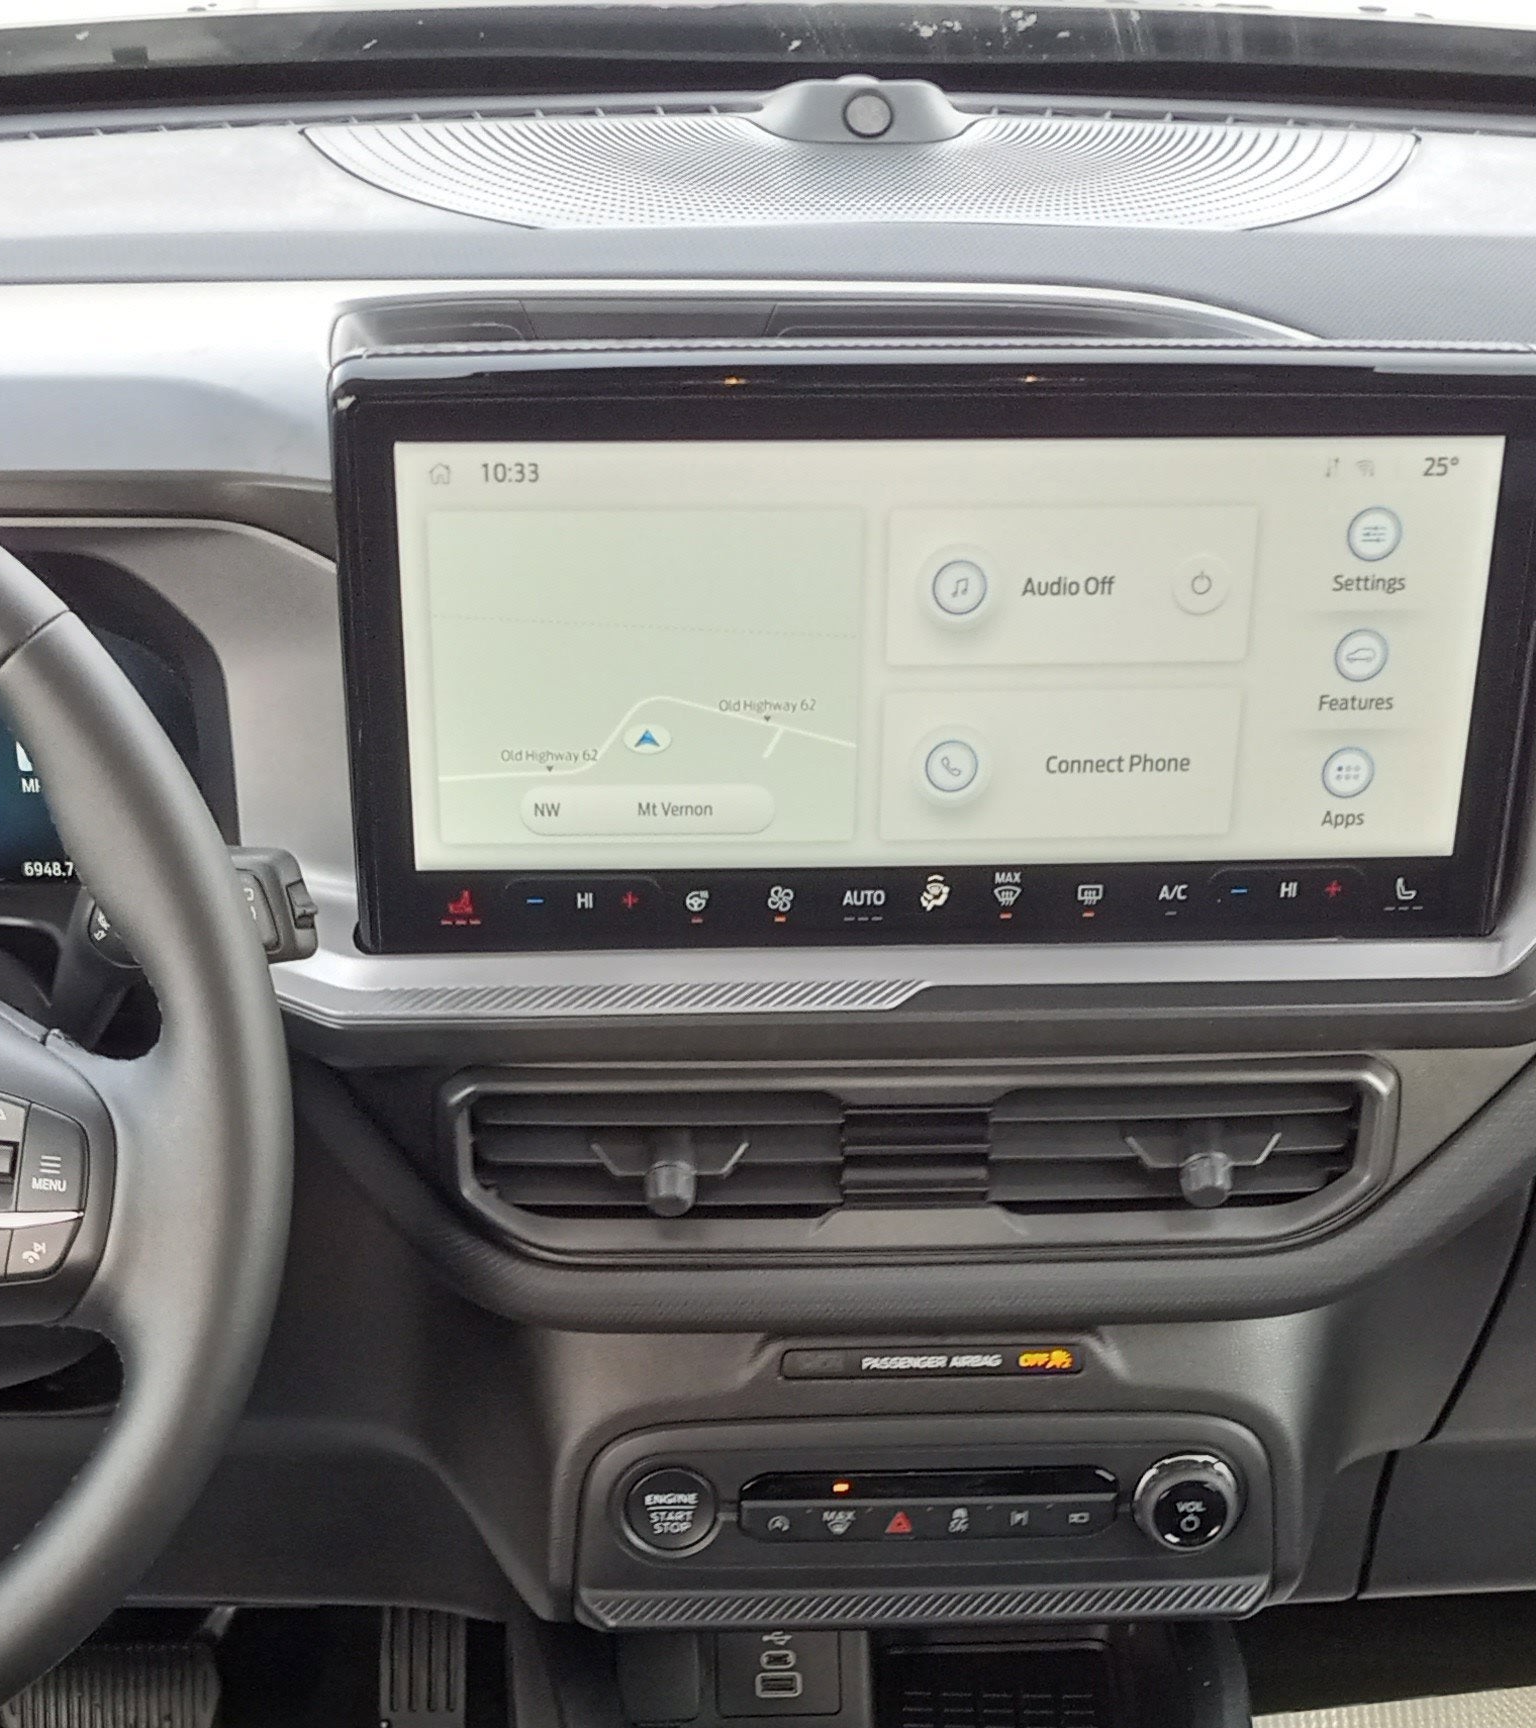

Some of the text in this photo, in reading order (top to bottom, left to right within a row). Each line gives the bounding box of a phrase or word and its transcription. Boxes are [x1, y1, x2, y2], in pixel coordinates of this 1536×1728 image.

[480, 463, 541, 484] 10:33
[1422, 456, 1460, 477] 25°
[1021, 575, 1115, 597] Audio Off
[1332, 573, 1407, 594] Settings
[718, 698, 817, 713] Old Highway 62
[1318, 693, 1394, 712] Features
[500, 748, 598, 763] Old Highway 62
[1045, 752, 1191, 775] Connect Phone
[533, 802, 561, 817] NW
[637, 801, 714, 817] Mt Vernon
[1320, 809, 1365, 829] Apps
[994, 871, 1022, 885] MAX
[1158, 883, 1189, 902] A/C
[1279, 880, 1298, 899] HI
[577, 892, 593, 909] HI
[843, 890, 886, 908] AUTO
[31, 1177, 67, 1193] MENU
[861, 1354, 947, 1371] PASSENGER
[948, 1353, 1003, 1369] AIRBAG
[645, 1492, 699, 1506] ENGINE
[1176, 1500, 1207, 1513] VOL
[650, 1510, 694, 1523] START
[653, 1521, 692, 1534] STOP
